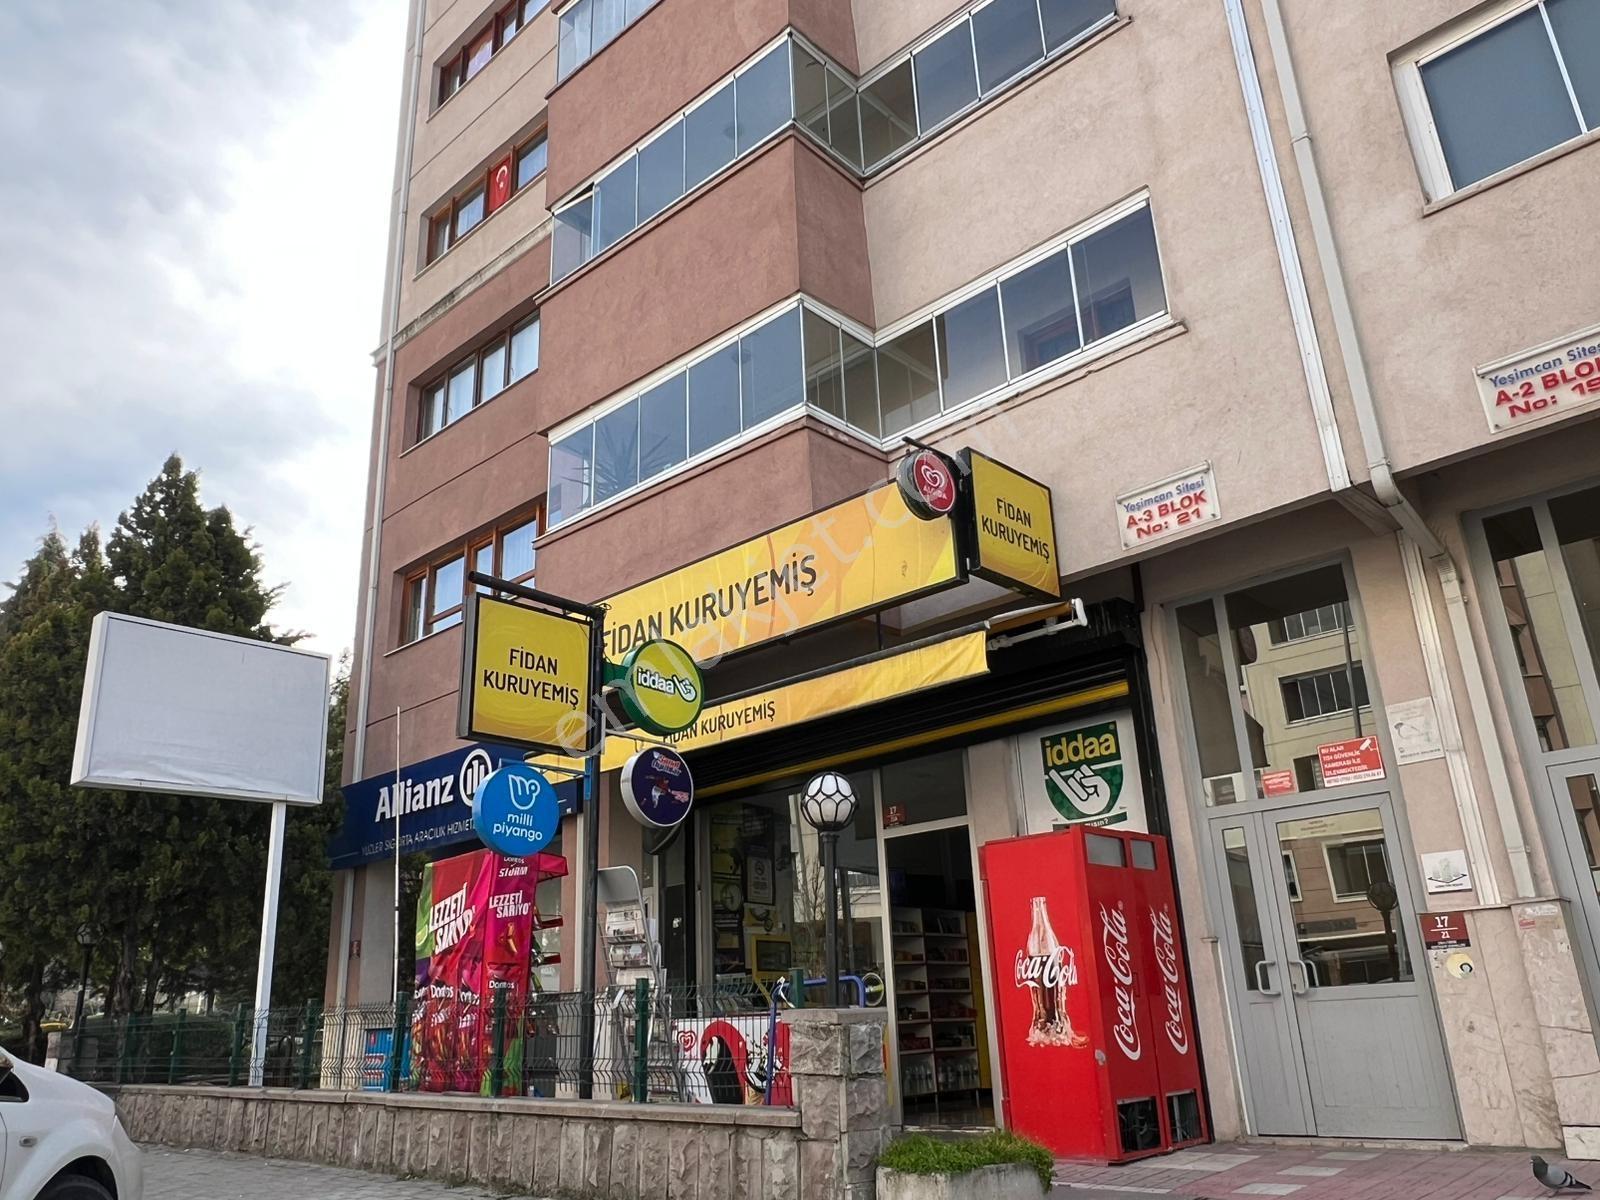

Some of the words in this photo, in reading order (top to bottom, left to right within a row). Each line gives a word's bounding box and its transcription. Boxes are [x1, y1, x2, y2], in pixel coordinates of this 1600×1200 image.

[1489, 357, 1563, 387] Yeşimcan
[1496, 381, 1535, 407] A-2
[1508, 394, 1557, 418] No:
[1123, 490, 1173, 513] Yeşimcan
[1175, 476, 1205, 496] Sitesi
[1126, 509, 1153, 529] A-3
[1157, 490, 1207, 518] BLOK
[996, 497, 1032, 529] FİDAN
[1136, 521, 1169, 539] No:
[1176, 508, 1202, 526] 21
[981, 515, 1050, 564] KURUYEMİŞ
[669, 552, 817, 636] KURUYEMİŞ
[508, 645, 558, 676] FİDAN
[483, 669, 580, 710] KURUYEMİŞ
[637, 667, 675, 695] iddaa
[701, 698, 776, 736] KURUYEMİŞ
[1045, 732, 1117, 768] iddaa
[374, 774, 454, 823] Allianz
[492, 823, 543, 842] piyango
[507, 812, 533, 827] milli
[1434, 916, 1449, 928] 17
[1014, 945, 1079, 988] Coca-Cola
[1099, 900, 1141, 1061] Coca-Cola
[1149, 904, 1189, 1055] Coca-Cola
